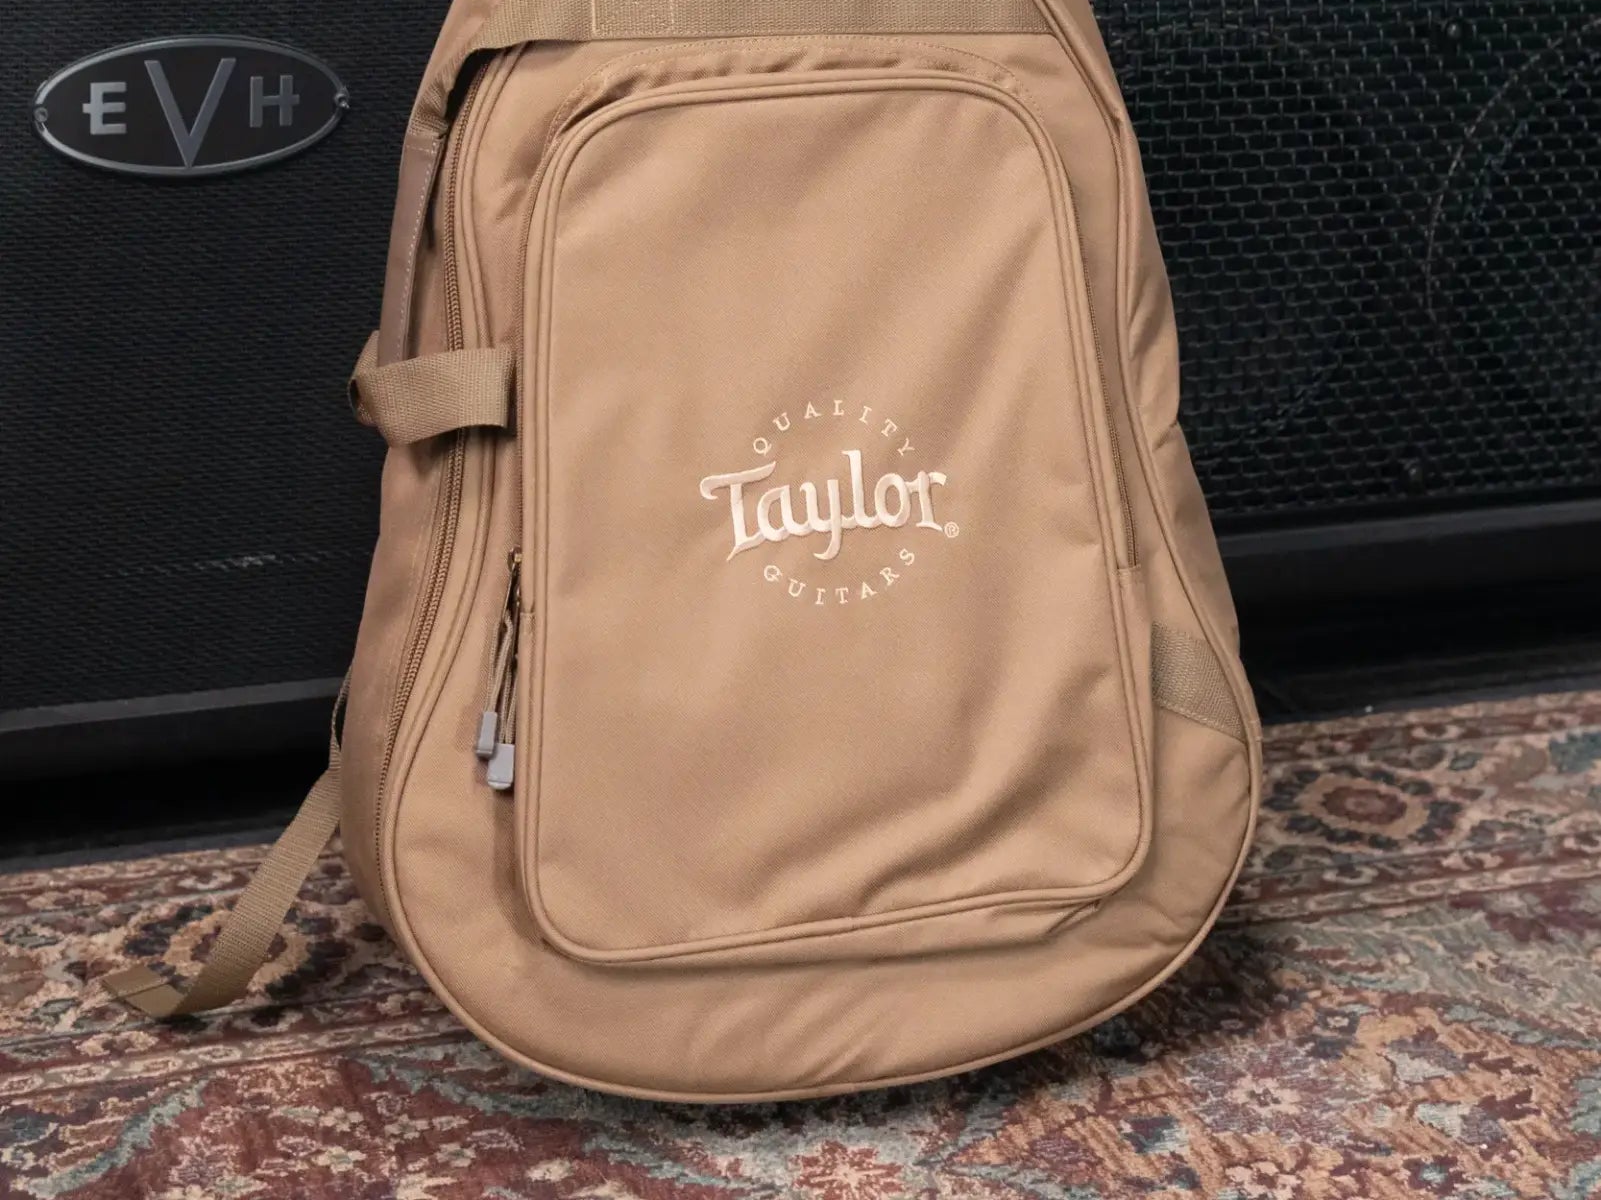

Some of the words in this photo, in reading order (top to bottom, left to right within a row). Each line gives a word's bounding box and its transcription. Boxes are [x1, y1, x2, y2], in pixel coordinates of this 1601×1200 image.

[82, 57, 300, 169] EVH
[752, 399, 915, 456] QUALITY
[763, 548, 915, 605] GUITARS
